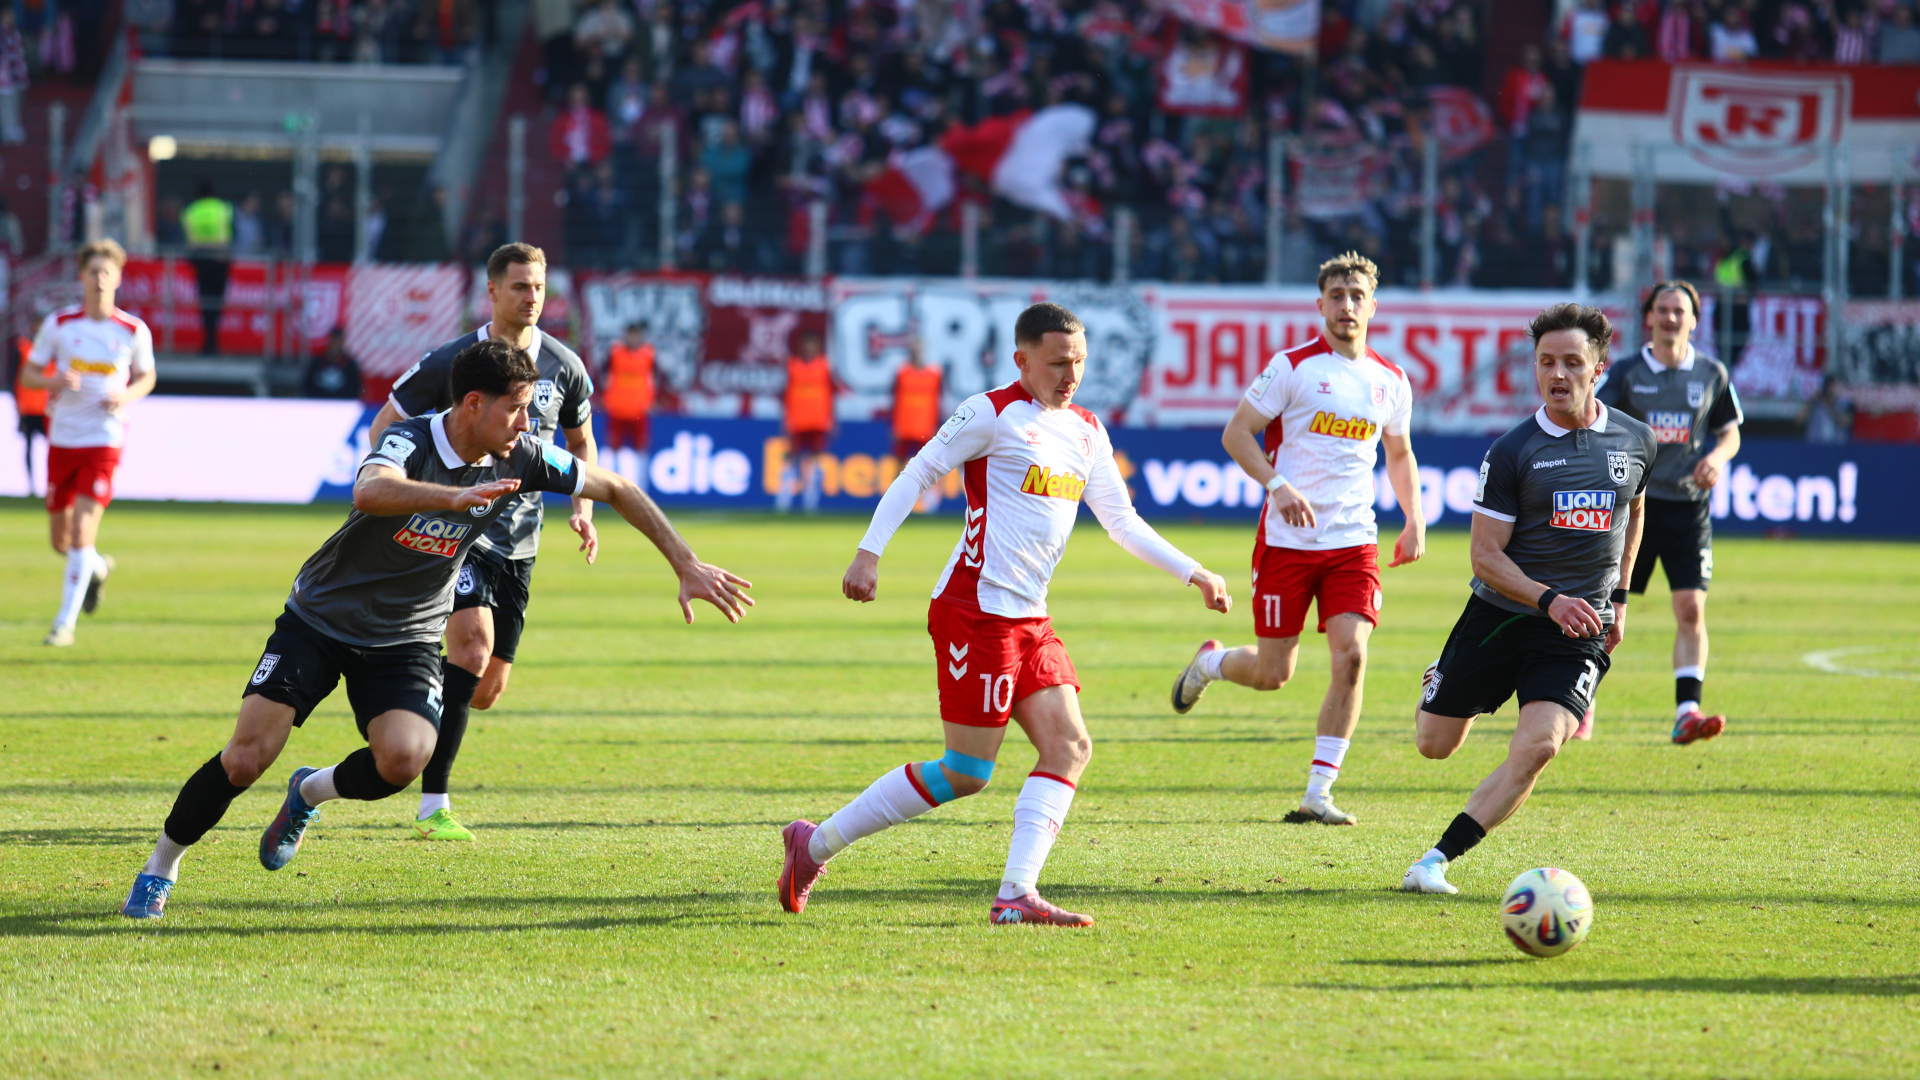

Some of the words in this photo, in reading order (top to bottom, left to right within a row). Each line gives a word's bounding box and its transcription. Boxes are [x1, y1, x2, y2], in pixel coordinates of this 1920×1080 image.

[650, 431, 752, 496] die
[1533, 458, 1567, 469] uhlsport
[1142, 458, 1264, 508] von
[1557, 492, 1613, 510] LIQUI
[408, 517, 468, 540] LIQUI
[1553, 509, 1611, 529] MOLY
[397, 530, 459, 554] MOLY
[1262, 594, 1281, 628] 11
[979, 673, 1014, 713] 10
